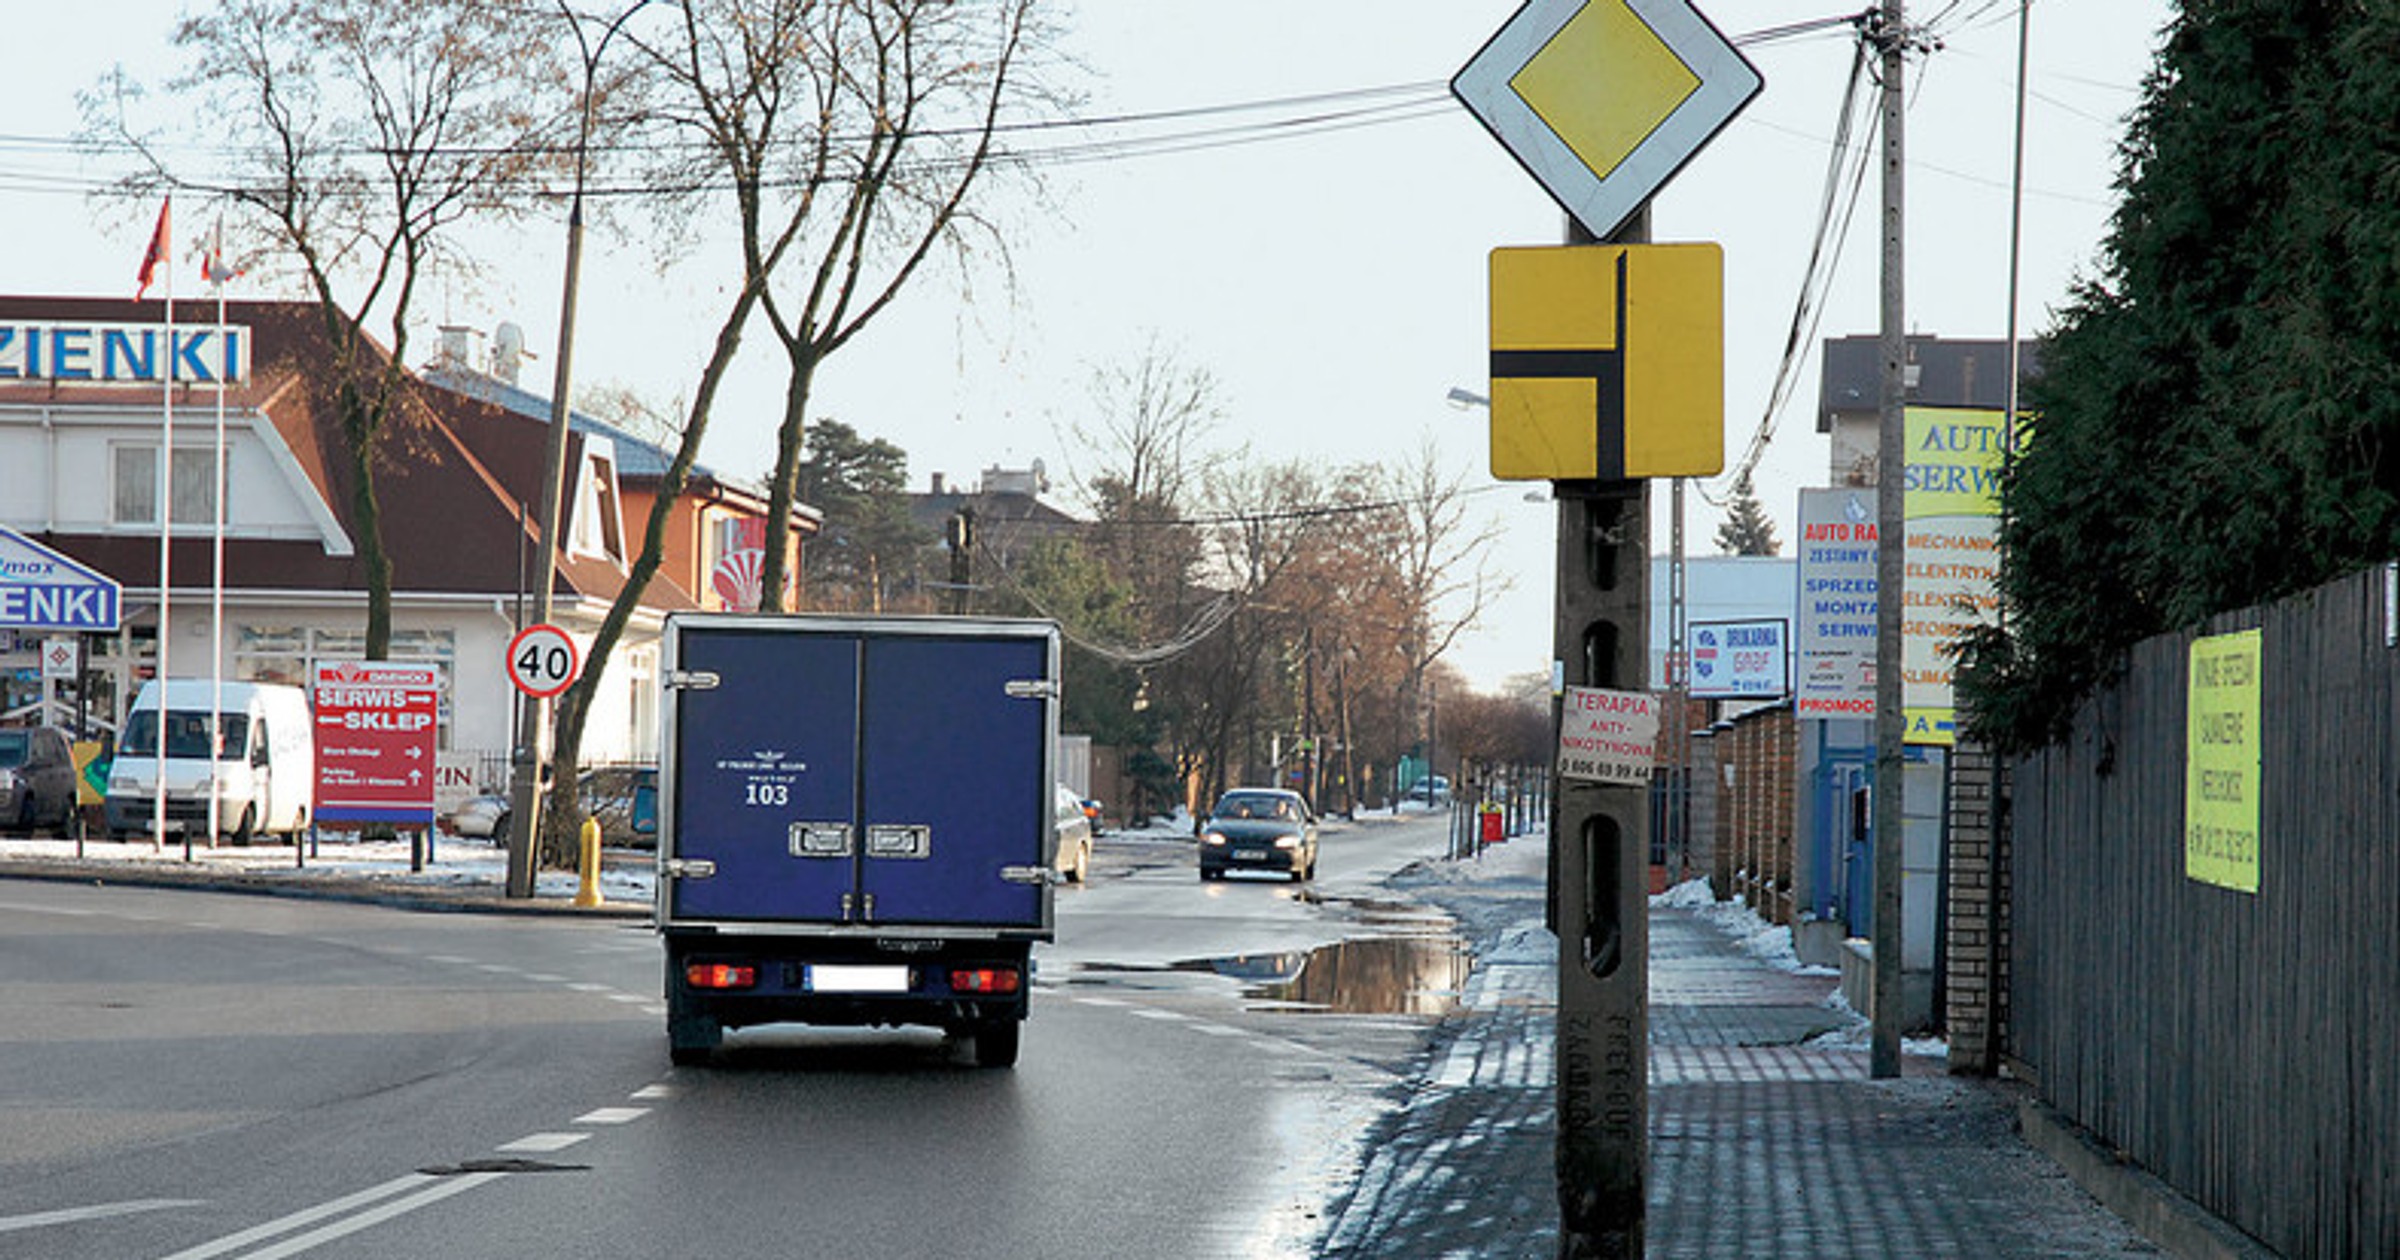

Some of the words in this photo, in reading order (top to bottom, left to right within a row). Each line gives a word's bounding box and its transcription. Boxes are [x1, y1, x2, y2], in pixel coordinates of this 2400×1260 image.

[1804, 523, 1850, 542] AUTO
[1854, 523, 1879, 542] RA
[518, 644, 568, 680] 40
[319, 689, 407, 708] SERWIS
[1577, 692, 1650, 717] TERAPIA
[1800, 698, 1876, 714] PROMOC
[345, 711, 432, 731] SKLEP
[1590, 720, 1632, 734] ANTY-
[1562, 736, 1653, 756] NIKOTYNOWA
[746, 783, 788, 805] 103
